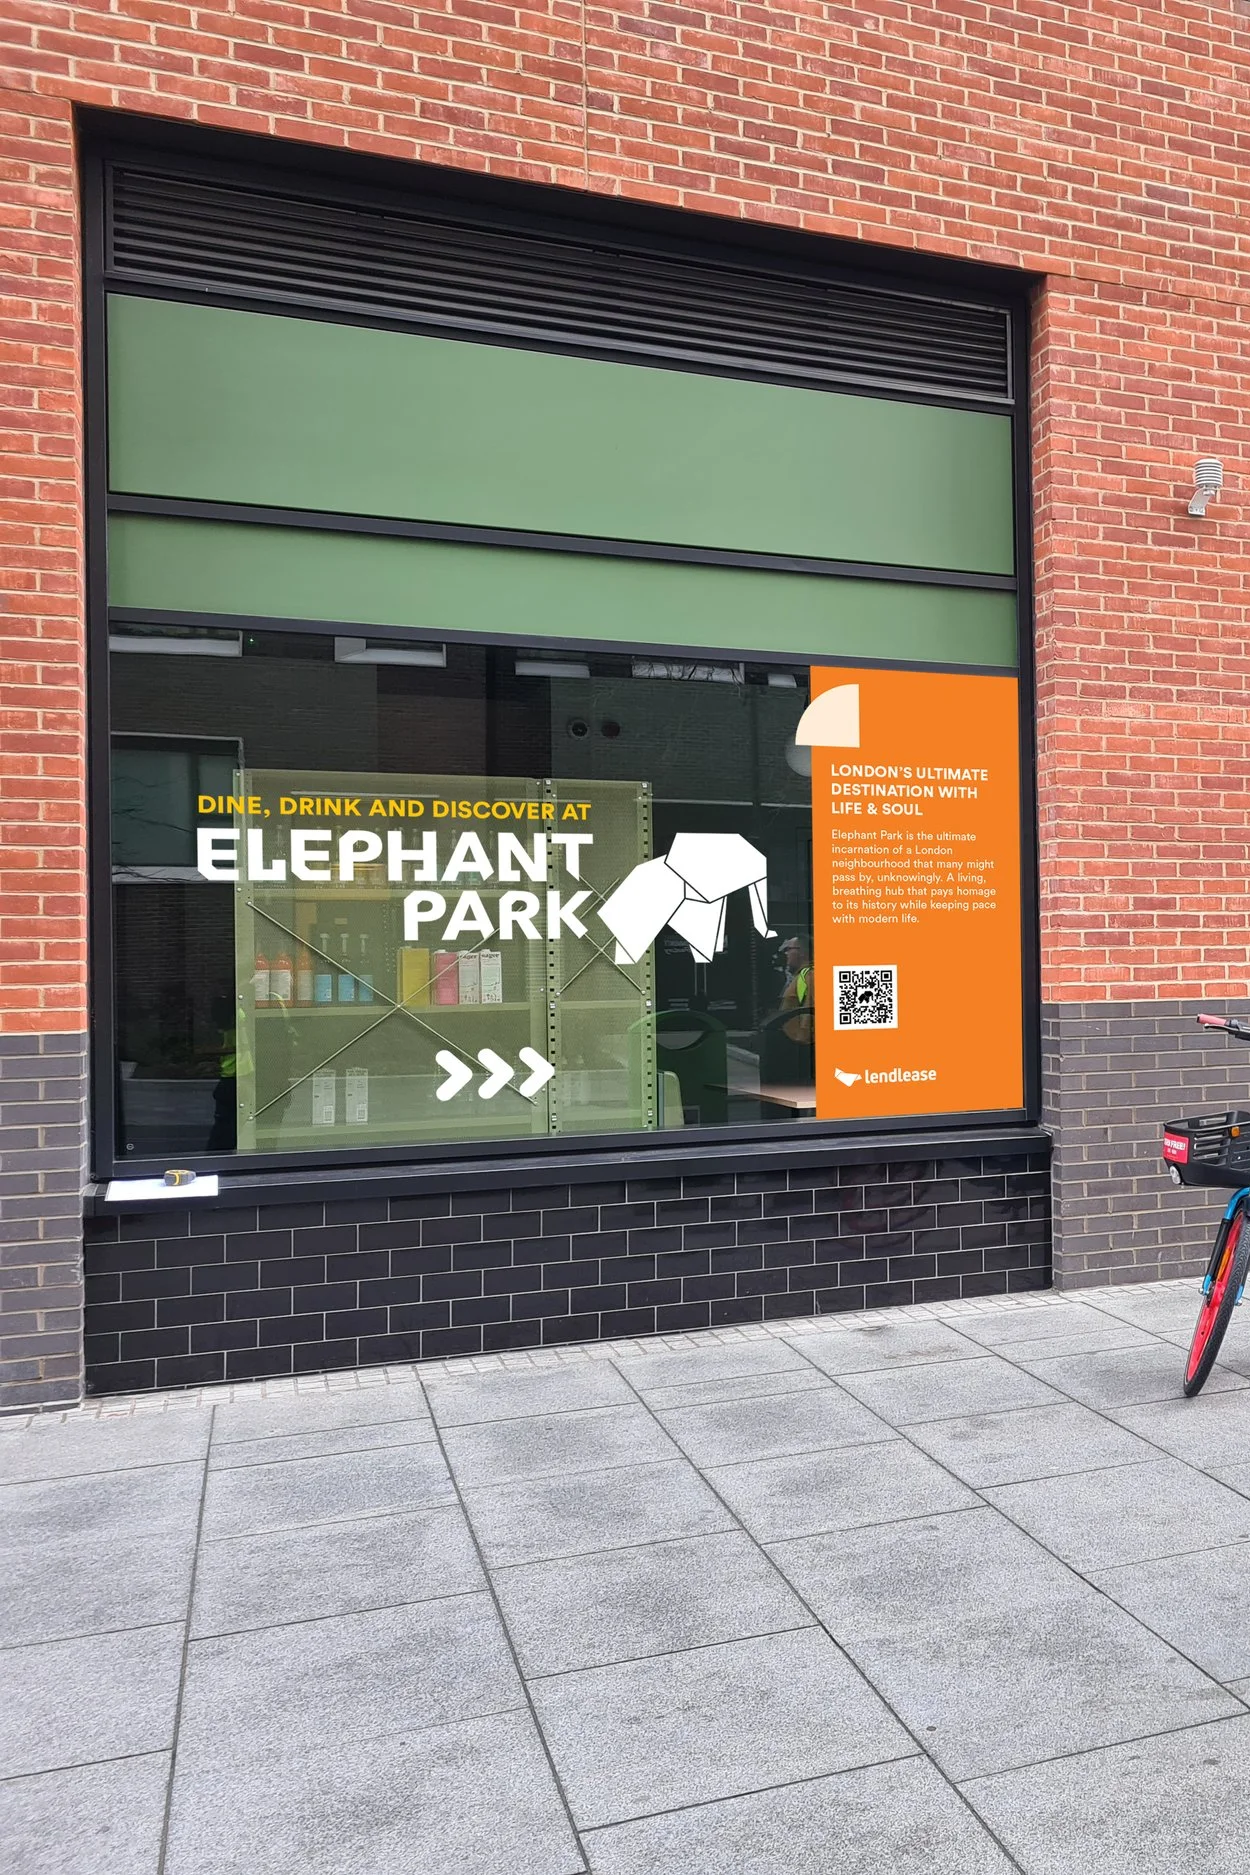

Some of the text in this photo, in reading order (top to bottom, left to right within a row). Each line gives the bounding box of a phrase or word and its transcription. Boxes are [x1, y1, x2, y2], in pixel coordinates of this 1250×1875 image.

[832, 764, 988, 781] LONDON'S ULTIMATE
[832, 783, 977, 798] DESTINATION WITH
[199, 796, 591, 819] DINE, DRINK AND DISCOVER AT
[832, 802, 923, 815] LIFE & SOUL
[832, 829, 976, 841] Elephant Park is the ultimate
[197, 828, 593, 881] ELEPHANT
[832, 844, 889, 854] incarnation
[893, 845, 902, 854] of
[916, 846, 952, 854] London
[833, 858, 993, 870] neighbourhood that many might
[833, 872, 985, 884] pass by, unknowingly. A living,
[833, 886, 996, 897] breathing hub that pays homage
[847, 900, 858, 909] its
[862, 900, 897, 911] history
[900, 900, 927, 909] while
[931, 900, 968, 911] keeping
[973, 902, 996, 910] pace
[404, 891, 592, 940] PARK
[833, 913, 920, 923] with modern life.
[865, 1068, 936, 1083] lendlease
